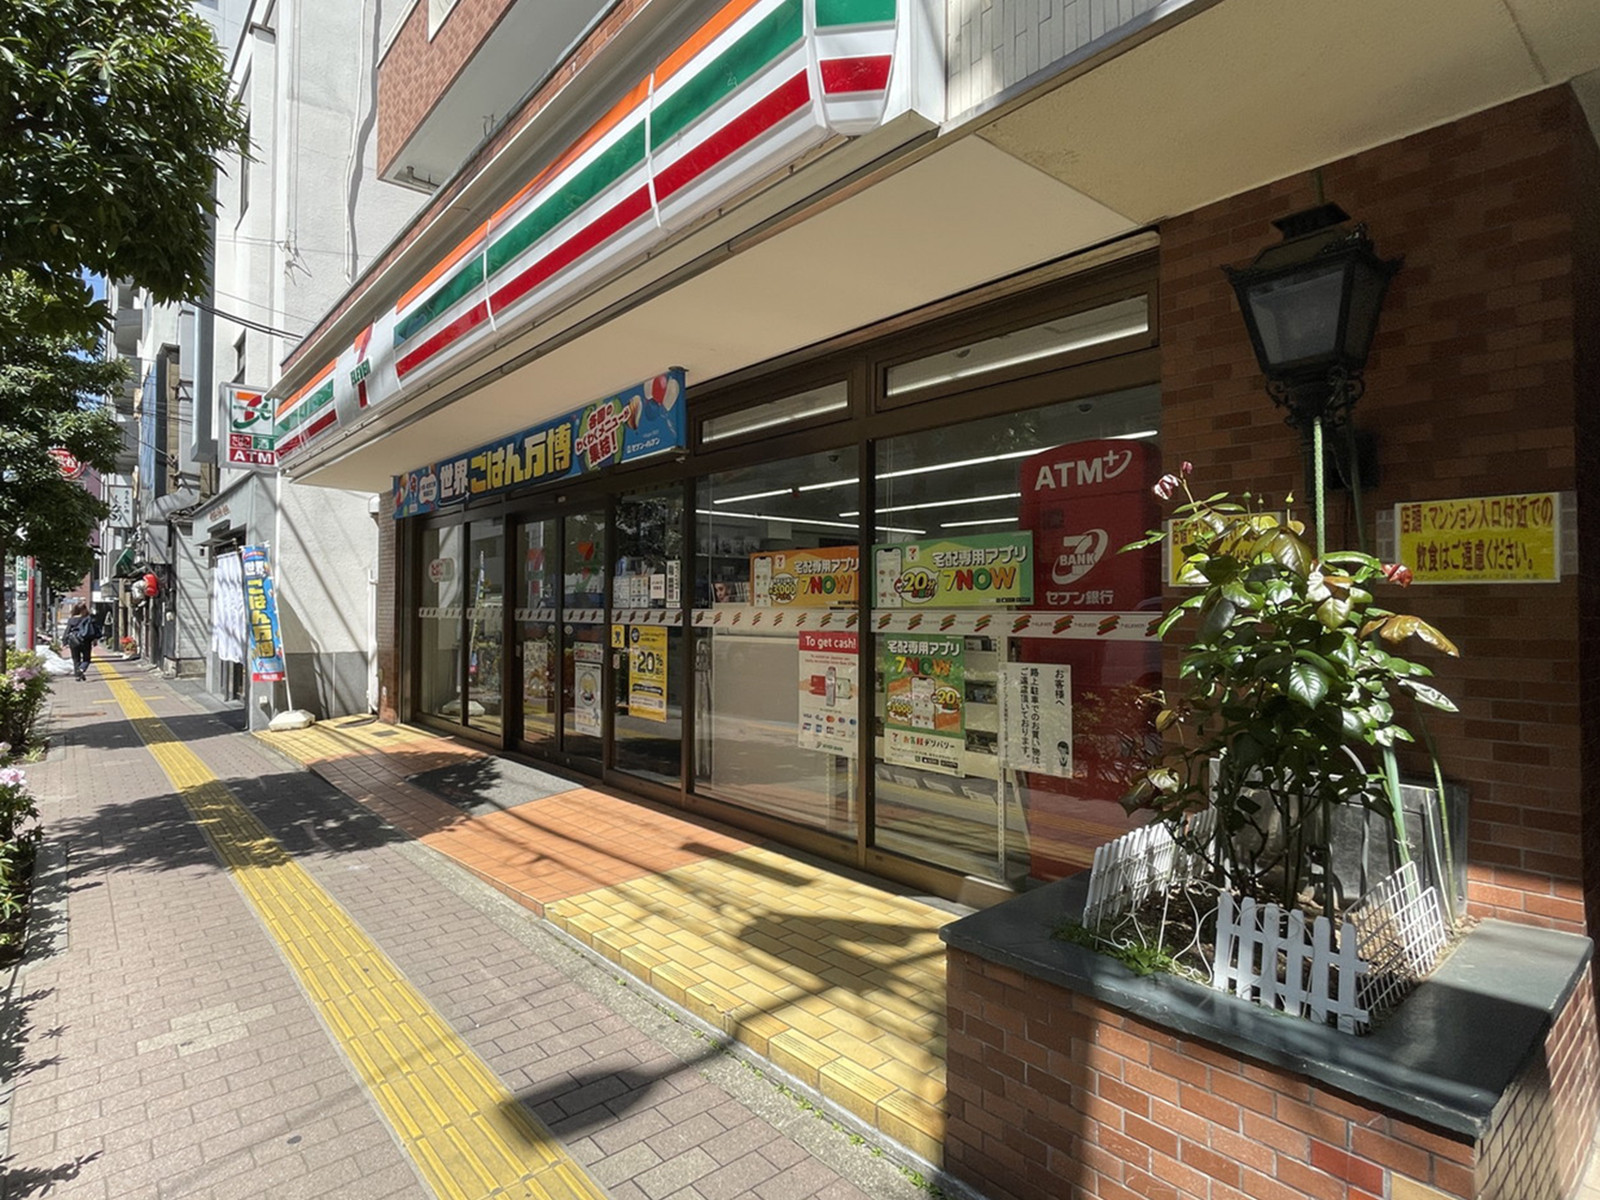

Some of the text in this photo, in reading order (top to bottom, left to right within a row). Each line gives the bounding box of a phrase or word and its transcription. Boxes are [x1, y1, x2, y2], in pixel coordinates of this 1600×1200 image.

[233, 450, 272, 463] ATM
[932, 545, 1027, 568] 宅配専用アプリ
[1059, 553, 1095, 567] BANK
[1416, 538, 1533, 572] 飲食はご遠慮ください。
[794, 557, 859, 574] 宅配専用アプリ
[801, 575, 852, 594] 7NOW
[943, 566, 1016, 591] 7NOW
[1046, 590, 1114, 605] セブン銀行
[805, 635, 857, 650] To get cash!
[887, 640, 960, 656] 宅配専用アプリ
[895, 656, 952, 676] 7NOW
[1055, 669, 1065, 706] お客様へ
